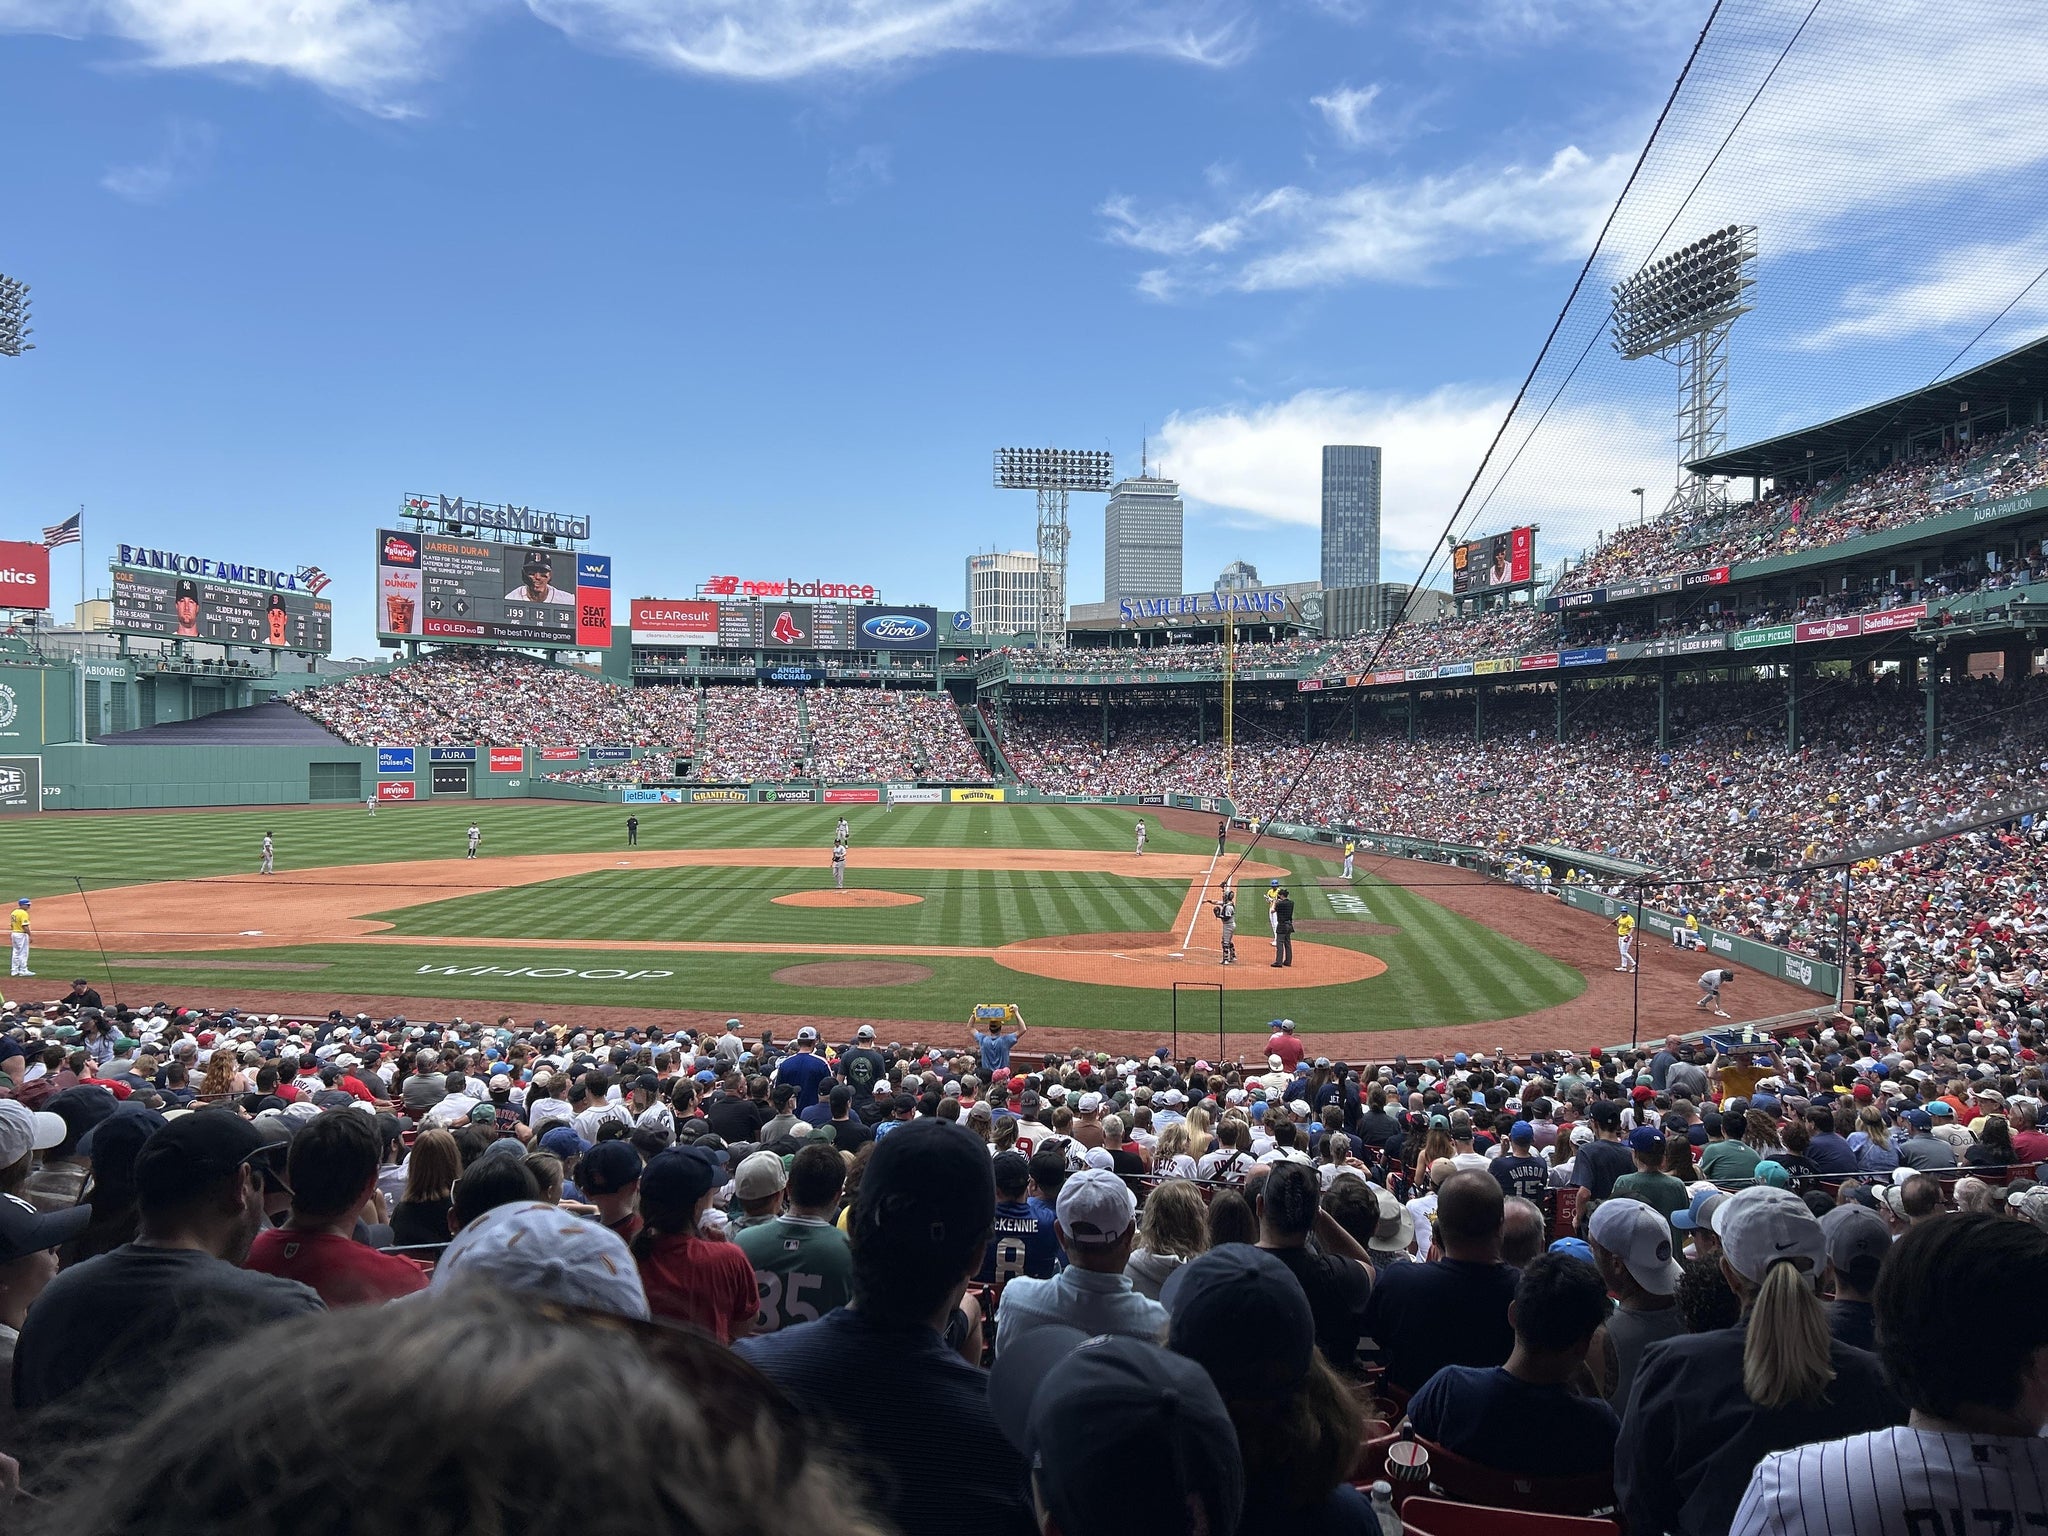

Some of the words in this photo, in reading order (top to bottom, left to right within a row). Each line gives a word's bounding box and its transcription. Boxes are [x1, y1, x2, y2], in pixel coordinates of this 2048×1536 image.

[1998, 498, 2032, 515] PAVILION
[439, 493, 590, 539] MassMutual
[384, 546, 417, 557] KRUNCHY
[425, 542, 458, 554] JARREN
[461, 547, 489, 557] DURAN
[117, 543, 179, 572] BANK
[185, 556, 211, 576] OF
[215, 561, 297, 590] AMERICA
[116, 572, 134, 582] COLE
[1686, 576, 1694, 585] LG
[1695, 574, 1709, 584] OLED
[385, 580, 417, 589] DUNKIN'
[742, 580, 785, 596] new
[787, 578, 875, 599] balance
[214, 585, 241, 595] CHALLENGES
[242, 589, 264, 598] REMAINING
[1565, 594, 1593, 606] UNITED
[216, 606, 233, 614] SLIDER
[430, 601, 441, 610] P7
[458, 603, 463, 611] K
[583, 606, 606, 616] SEAT
[1119, 596, 1205, 624] SAMUEL
[1208, 590, 1286, 613] ADAMS
[507, 609, 523, 617] .199
[536, 611, 544, 619] 12
[640, 610, 709, 620] CLEAResult
[226, 616, 244, 624] STRIKES
[582, 617, 606, 628] GEEK
[1864, 617, 1893, 630] Safelite
[212, 625, 215, 636] 1
[232, 626, 237, 638] 2
[251, 629, 257, 640] 0
[443, 624, 466, 632] OLED
[875, 618, 916, 637] Ford
[1808, 626, 1826, 636] Ninety
[1835, 623, 1848, 632] Nine
[1768, 630, 1791, 642] PICKLES
[1682, 641, 1700, 650] SLIDER
[1710, 639, 1723, 647] MPH
[85, 666, 125, 677] ABIOMED
[771, 673, 812, 681] ORCHARD
[380, 753, 393, 761] city
[556, 750, 578, 758] TICKET
[42, 787, 61, 795] 379
[626, 792, 656, 801] jetBlue
[693, 790, 728, 800] GRANITE
[729, 790, 746, 800] CITY
[984, 792, 994, 800] TEA
[1785, 956, 1800, 968] Ninety
[416, 964, 674, 980] WHOOP
[1785, 965, 1800, 980] Nine
[1509, 1165, 1544, 1180] MUNSON
[994, 1218, 1039, 1233] cKENNIE
